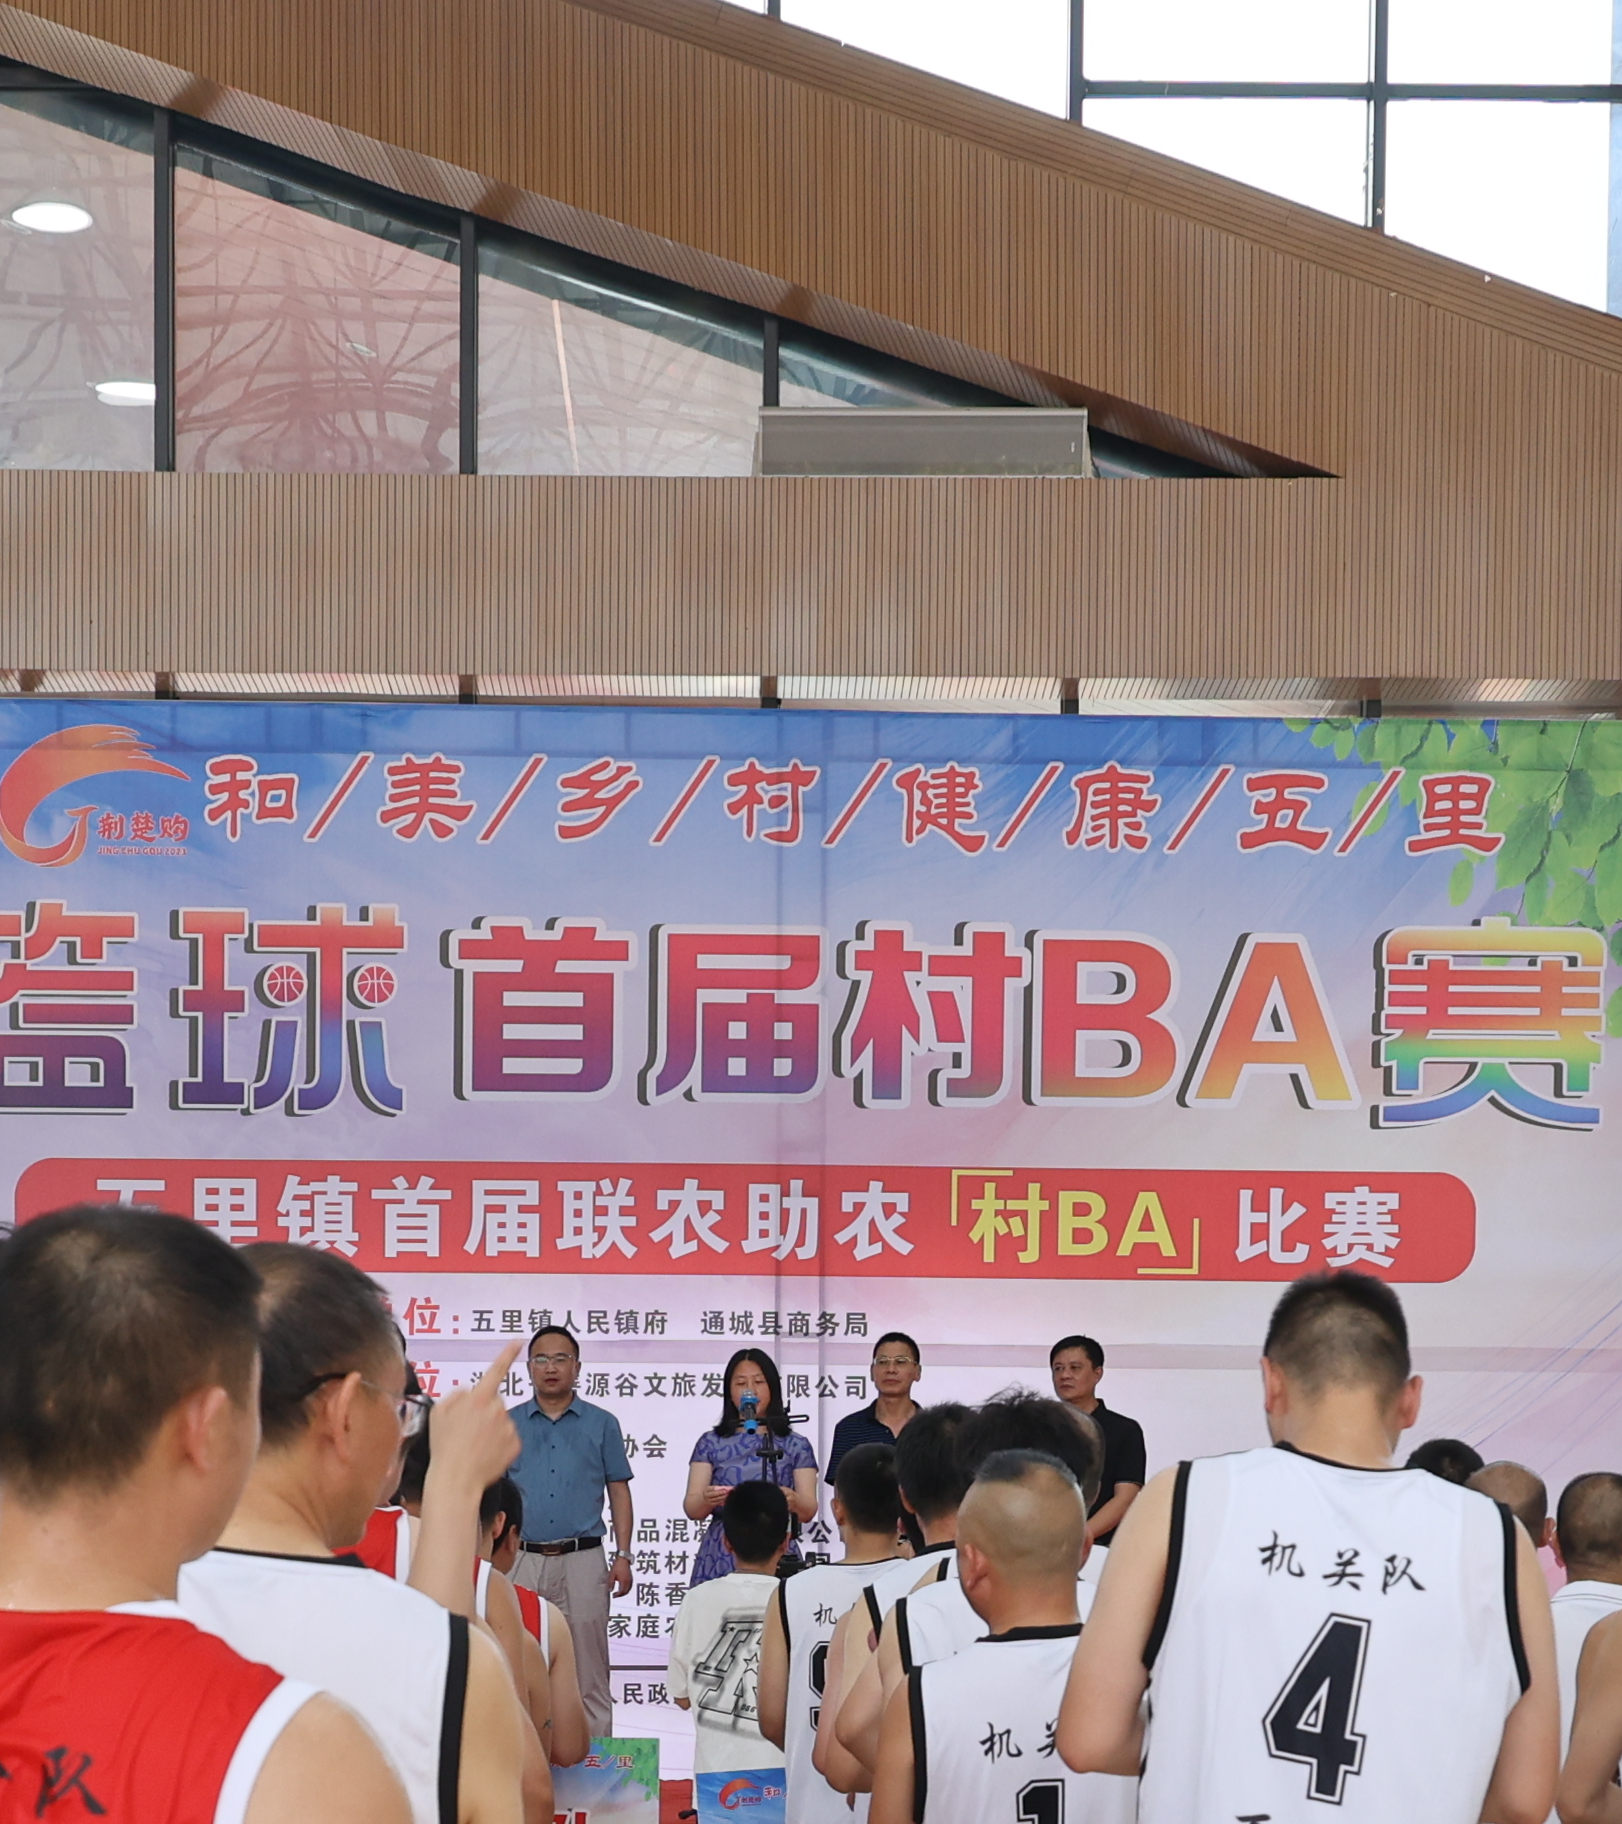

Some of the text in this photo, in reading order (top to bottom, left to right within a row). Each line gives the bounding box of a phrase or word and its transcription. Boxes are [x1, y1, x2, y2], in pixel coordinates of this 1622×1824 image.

[97, 811, 190, 843] 荆楚购
[470, 1308, 669, 1336] 五里镇人民镇府
[700, 1310, 869, 1337] 通城县商务局
[1257, 1530, 1427, 1597] 机关队
[1261, 1611, 1372, 1806] 4
